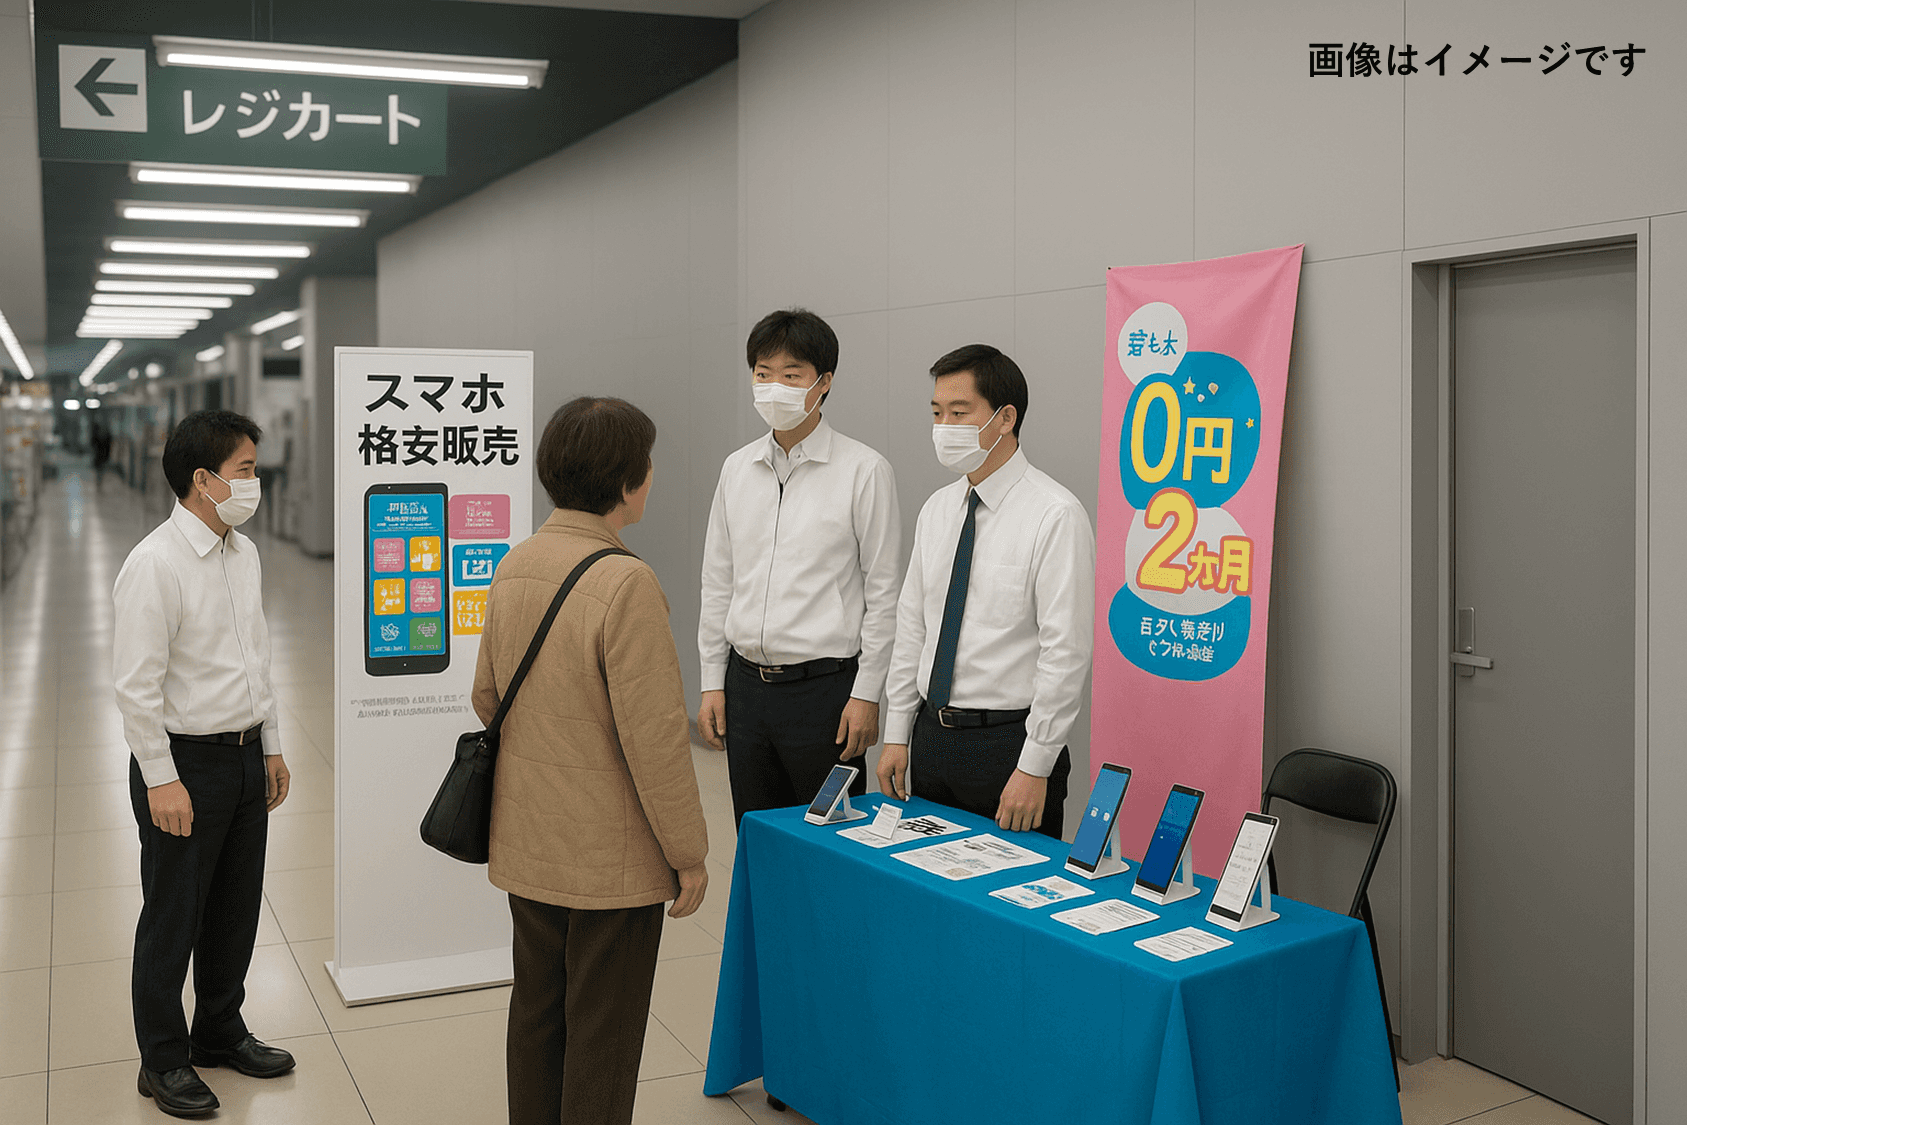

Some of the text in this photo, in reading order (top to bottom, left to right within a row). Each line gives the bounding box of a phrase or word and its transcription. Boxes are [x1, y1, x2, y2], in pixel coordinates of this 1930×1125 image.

[183, 89, 421, 145] レジカート
[365, 372, 505, 414] スマホ
[1131, 381, 1234, 484] 0円
